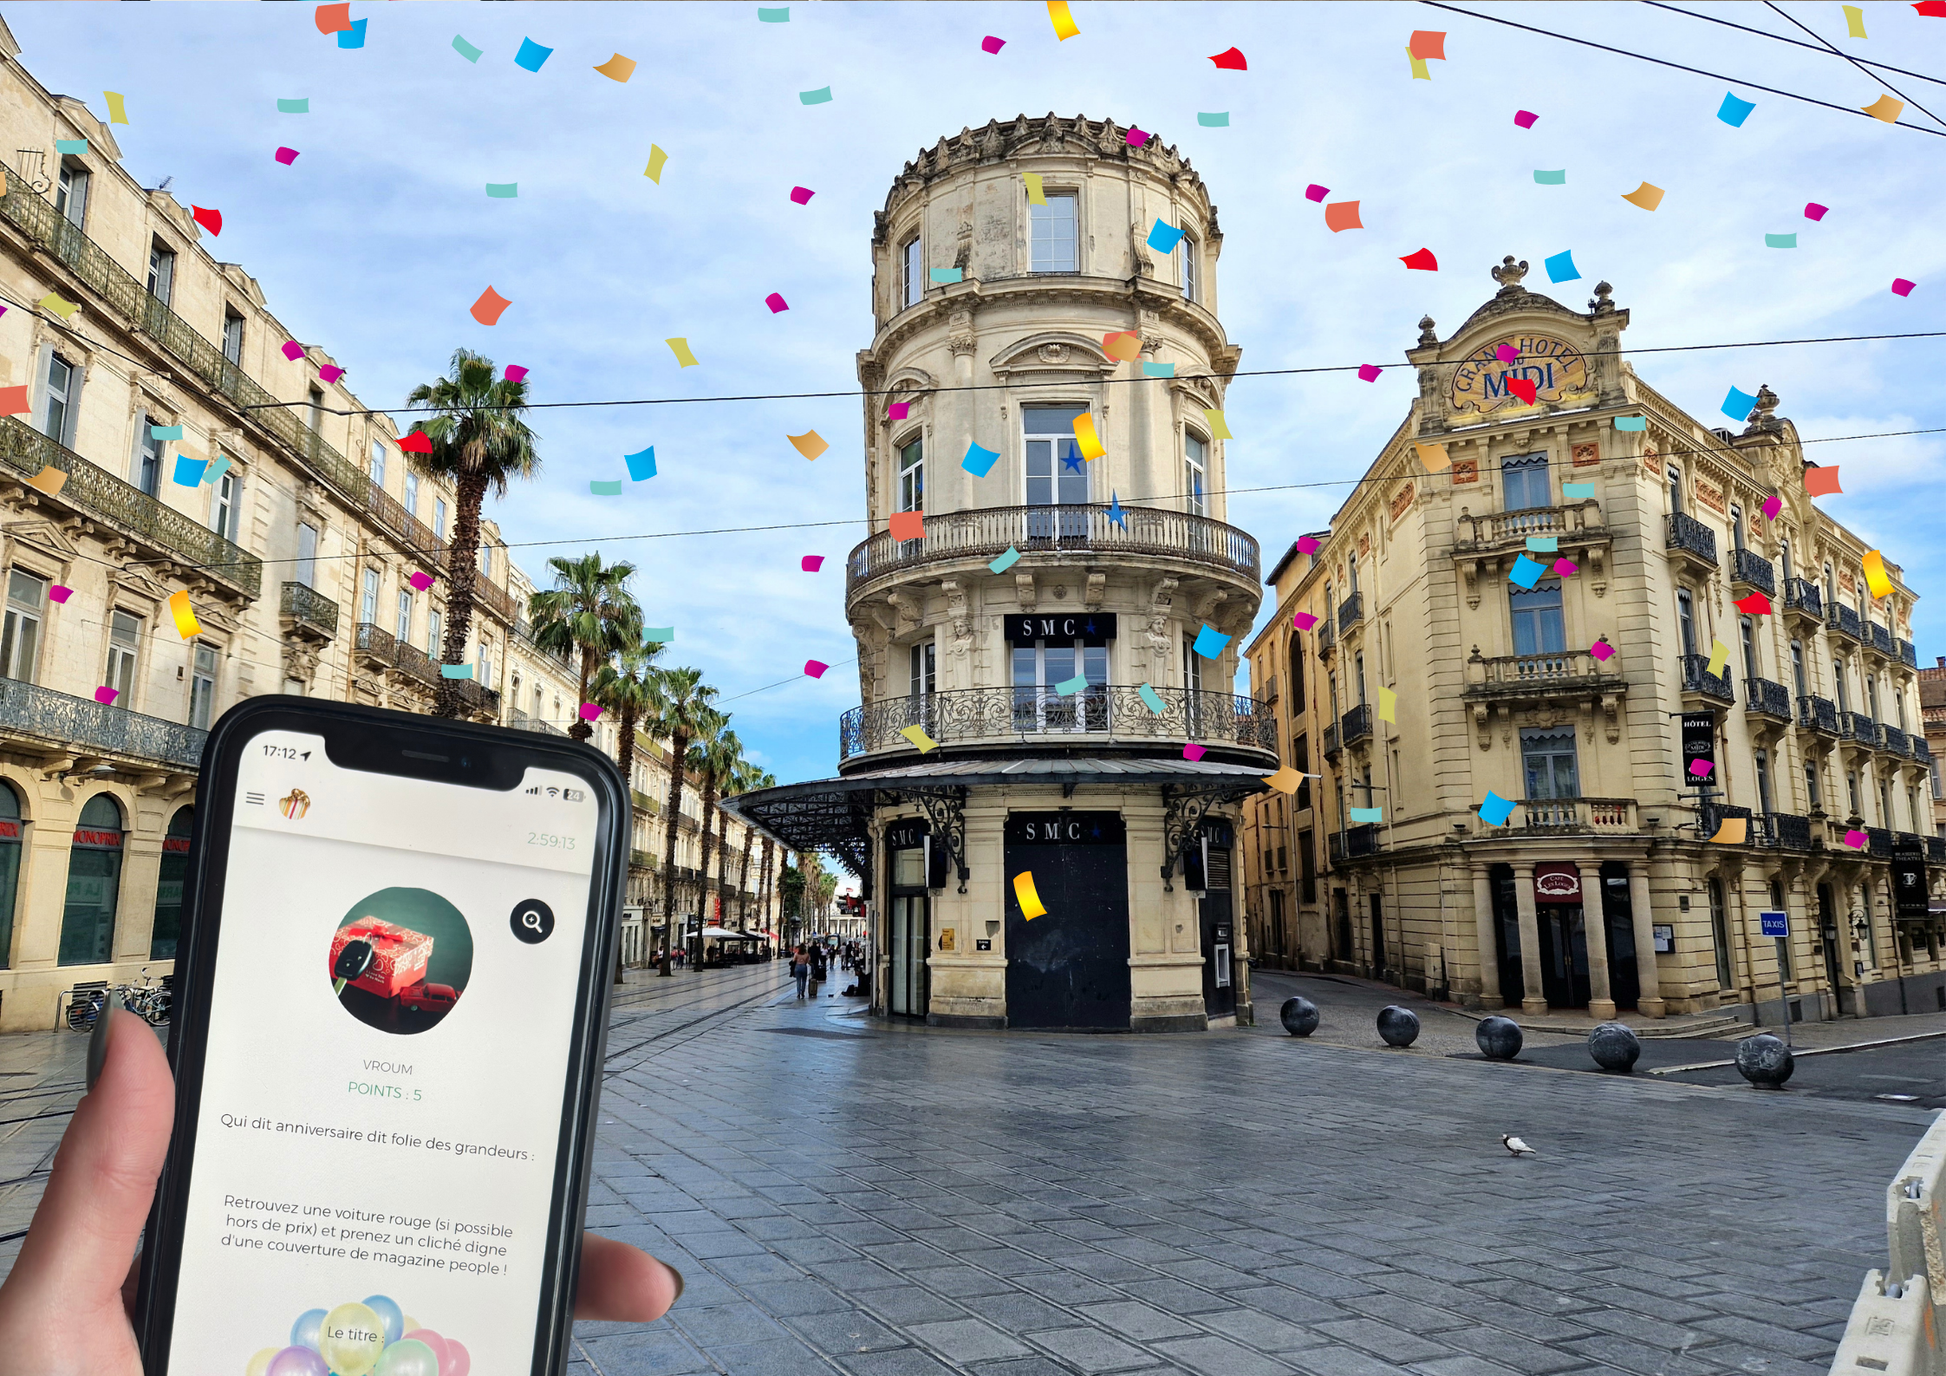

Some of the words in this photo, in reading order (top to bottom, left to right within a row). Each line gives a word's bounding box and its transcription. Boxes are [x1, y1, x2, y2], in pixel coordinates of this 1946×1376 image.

[1455, 341, 1510, 393] GRAN
[1519, 337, 1579, 373] HOTEL
[1023, 619, 1075, 637] SMC
[1684, 720, 1712, 728] HÔTEL
[263, 745, 297, 760] 17:12
[567, 790, 580, 800] 24
[1026, 822, 1080, 840] SMC
[527, 831, 576, 850] 2:59:13
[1763, 920, 1785, 928] TAXIS
[363, 1060, 413, 1075] VROUM
[348, 1082, 402, 1099] POINTS
[413, 1089, 422, 1101] 5
[221, 1114, 248, 1129] Qui
[251, 1117, 272, 1131] dit
[276, 1122, 364, 1140] anniversaire
[367, 1130, 388, 1144] dit
[391, 1133, 422, 1147] folie
[426, 1137, 452, 1151] des
[455, 1143, 528, 1160] grandeurs
[225, 1195, 299, 1214] Retrouvez
[303, 1206, 332, 1218] une
[335, 1208, 386, 1224] voiture
[389, 1216, 431, 1231] rouge
[436, 1218, 450, 1232] (si
[455, 1222, 513, 1238] possible
[226, 1214, 258, 1229] hors
[262, 1219, 282, 1232] de
[285, 1222, 318, 1238] prix)
[321, 1226, 336, 1238] et
[341, 1229, 391, 1244] prenez
[396, 1235, 414, 1246] un
[418, 1235, 462, 1251] cliché
[465, 1241, 507, 1258] digne
[221, 1234, 264, 1249] d'une
[268, 1240, 346, 1258] couverture
[350, 1247, 370, 1261] de
[373, 1252, 446, 1268] magazine
[449, 1261, 500, 1276] people
[328, 1326, 344, 1339] Le
[349, 1329, 378, 1343] titre
